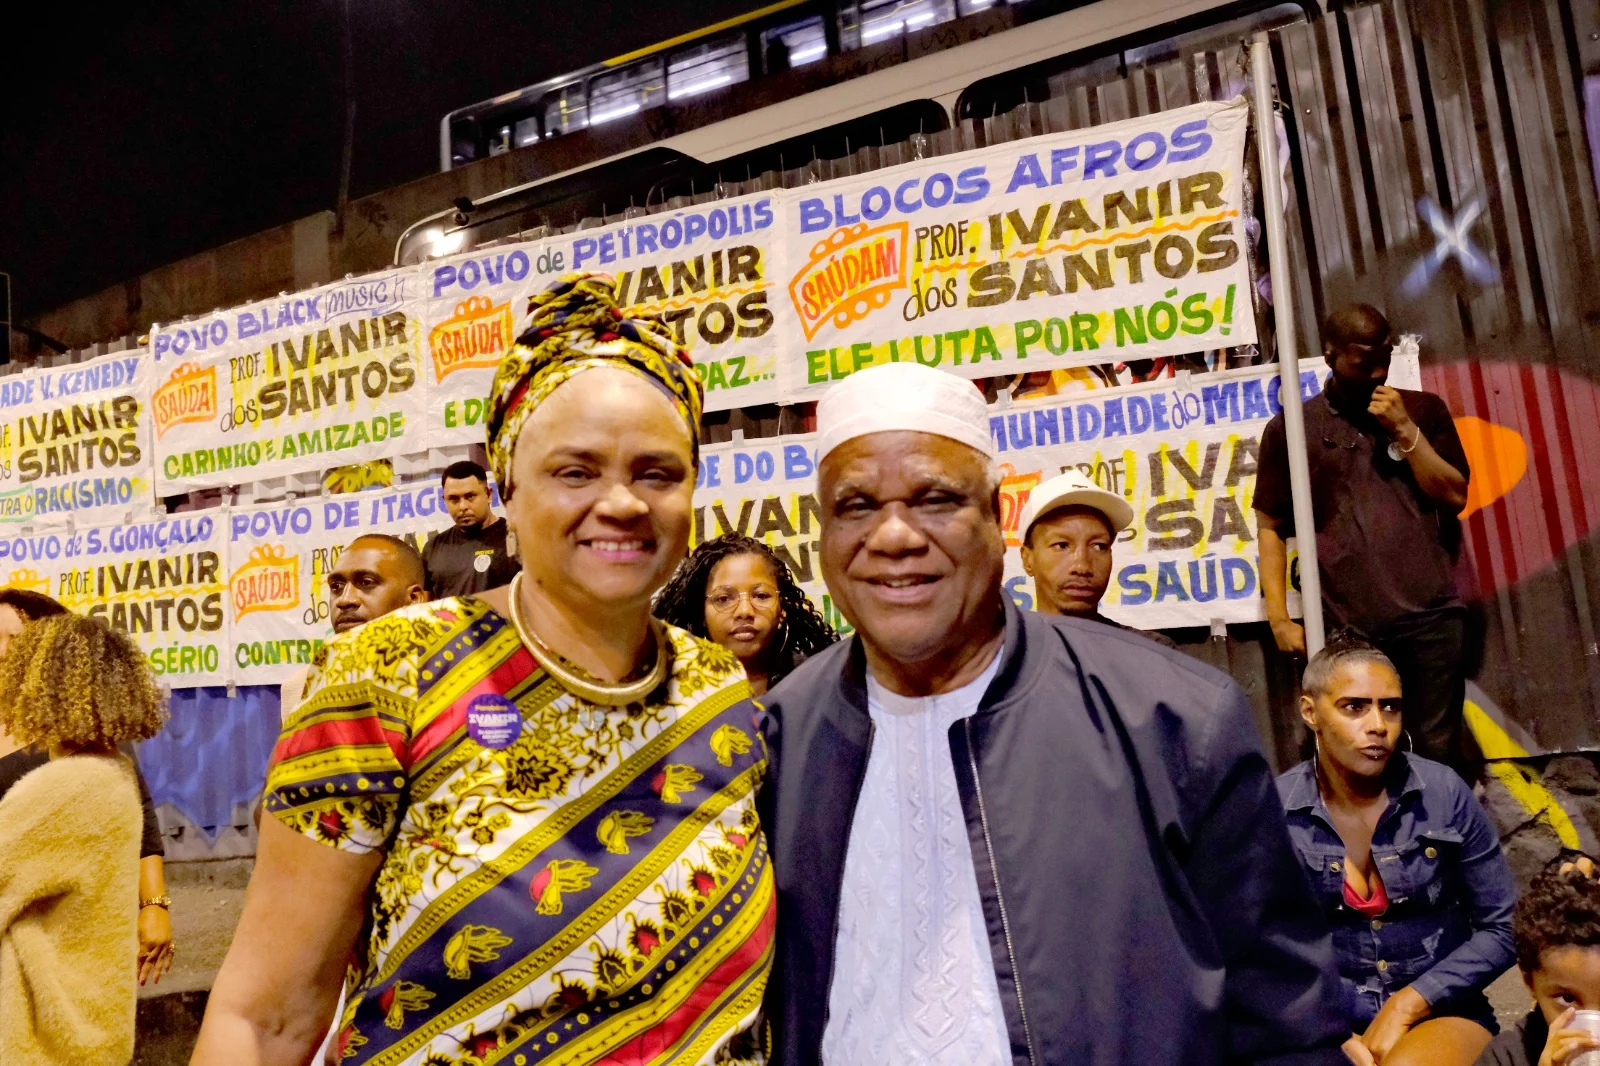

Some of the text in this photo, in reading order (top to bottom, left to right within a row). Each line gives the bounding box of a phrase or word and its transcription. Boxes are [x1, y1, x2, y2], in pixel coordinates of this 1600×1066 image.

[799, 119, 1213, 235] BLOCOS AFROS
[915, 171, 1228, 264] PROF. IVANIR
[433, 198, 774, 298] POVO de PETRÓPOLIS
[903, 221, 1240, 323] dos SANTOS
[801, 238, 900, 321] SAÚDAM
[154, 281, 388, 361] POVO BLACK MUSIC
[439, 320, 505, 366] SAÚDA
[1015, 314, 1100, 360] POR
[1114, 283, 1237, 347] NÓS!
[229, 312, 408, 384] PROF. IVANIR
[58, 358, 139, 397] KENEDY
[158, 381, 210, 424] SAÚDA
[220, 353, 415, 433] dos SANTOS
[18, 395, 139, 448] IVANIR
[1171, 390, 1200, 430] do
[18, 432, 141, 483] SANTOS
[164, 440, 260, 480] CARINHO
[280, 411, 405, 459] AMIZADE
[733, 450, 775, 484] DO
[783, 444, 819, 480] B
[35, 476, 133, 515] RACISMO
[230, 507, 312, 542] POVO
[324, 500, 360, 530] DE
[0, 535, 61, 562] POVO
[65, 531, 82, 557] de
[312, 545, 344, 575] PRO
[59, 551, 219, 596] PROF. IVANIR
[235, 568, 291, 611] SAÚDA
[1117, 552, 1264, 606] SAÚD
[150, 641, 218, 676] SÉRIO
